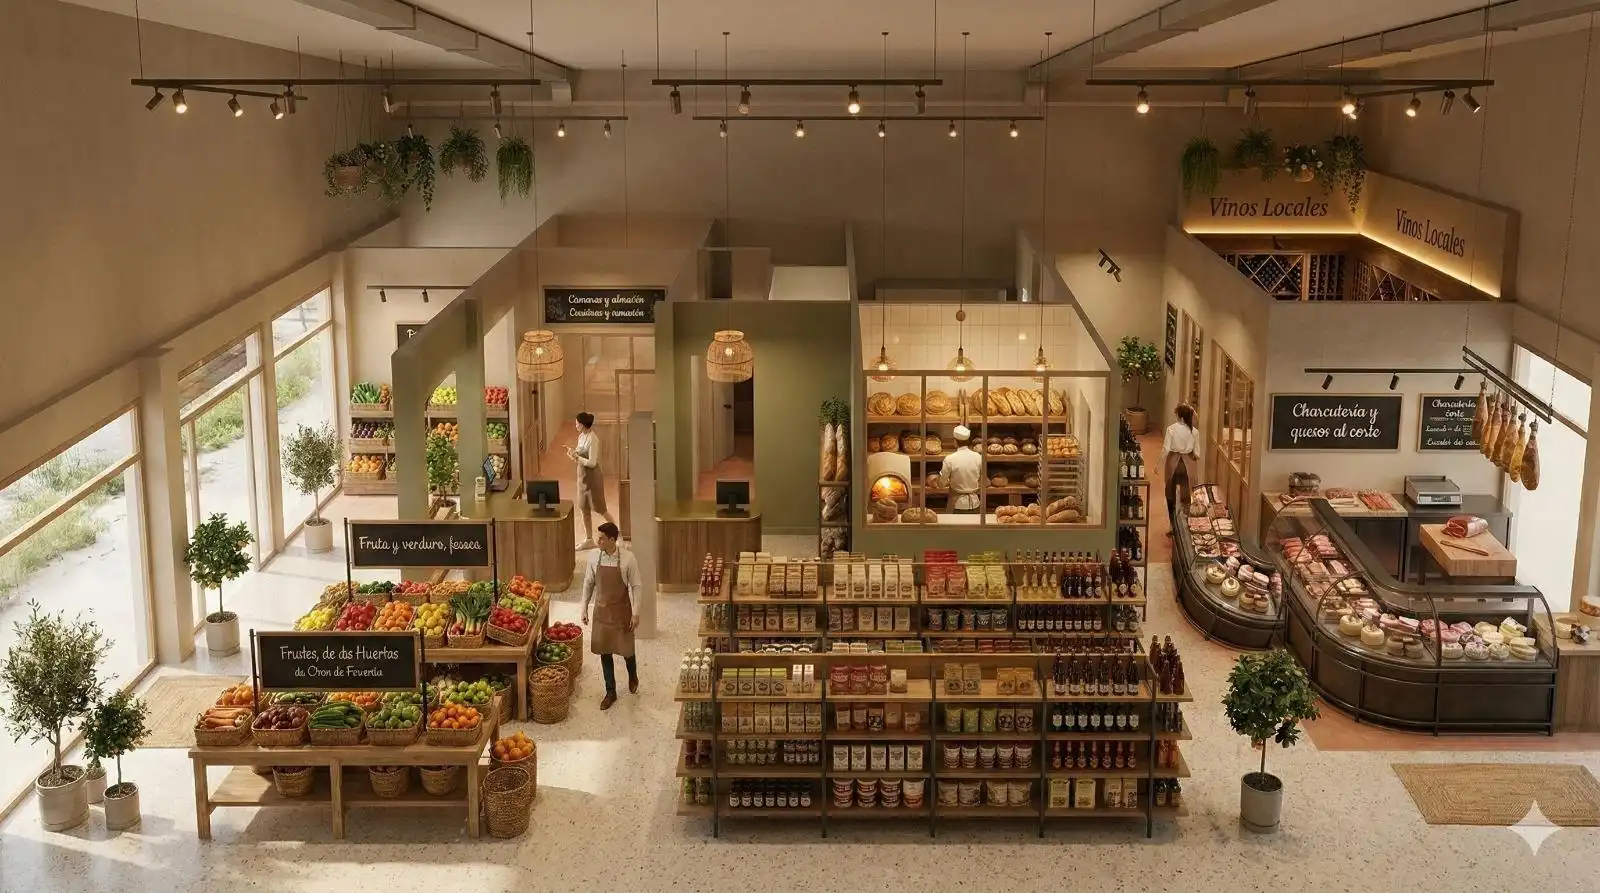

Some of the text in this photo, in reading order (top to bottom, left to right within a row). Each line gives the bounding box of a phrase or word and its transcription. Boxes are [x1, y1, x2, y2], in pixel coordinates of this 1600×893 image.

[1209, 197, 1329, 217] Vinos Locales
[1396, 208, 1465, 258] Vinos Locales
[604, 297, 611, 308] y
[604, 309, 611, 321] y
[1292, 402, 1379, 424] Charcutería y
[1333, 423, 1348, 438] al
[358, 536, 391, 550] Fruta
[392, 542, 400, 555] y
[322, 645, 336, 660] de
[333, 666, 345, 677] de
